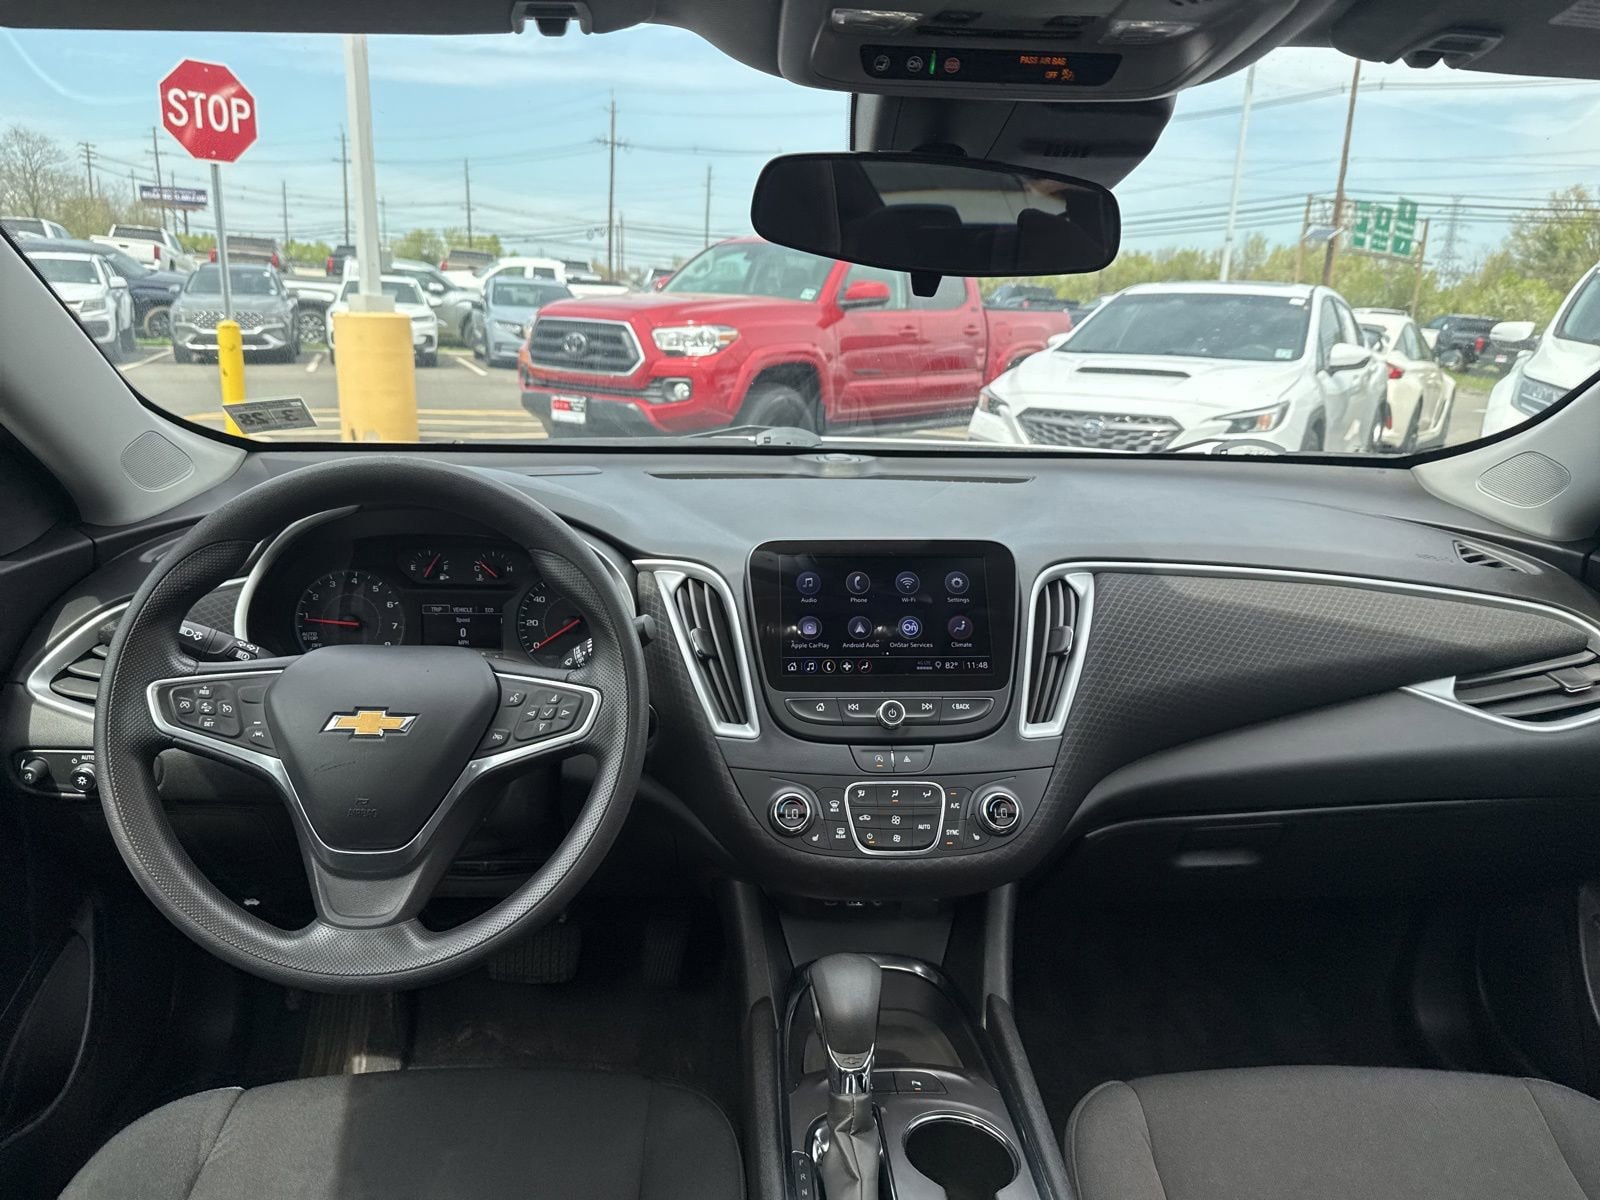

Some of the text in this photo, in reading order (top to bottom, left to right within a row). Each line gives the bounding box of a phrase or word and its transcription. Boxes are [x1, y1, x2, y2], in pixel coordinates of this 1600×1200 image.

[1019, 55, 1067, 66] PASS AIR BAG
[1045, 71, 1058, 79] OFF
[167, 87, 251, 134] STOP
[329, 580, 336, 588] 3
[351, 577, 358, 585] 4
[372, 585, 379, 593] 5
[312, 593, 319, 601] 2
[391, 622, 398, 630] 7
[526, 619, 539, 627] 20
[460, 627, 467, 638] 0
[533, 641, 541, 649] 0
[945, 661, 959, 669] 82°
[967, 661, 988, 669] 11:48
[800, 1173, 806, 1181] R
[801, 1188, 808, 1197] N
